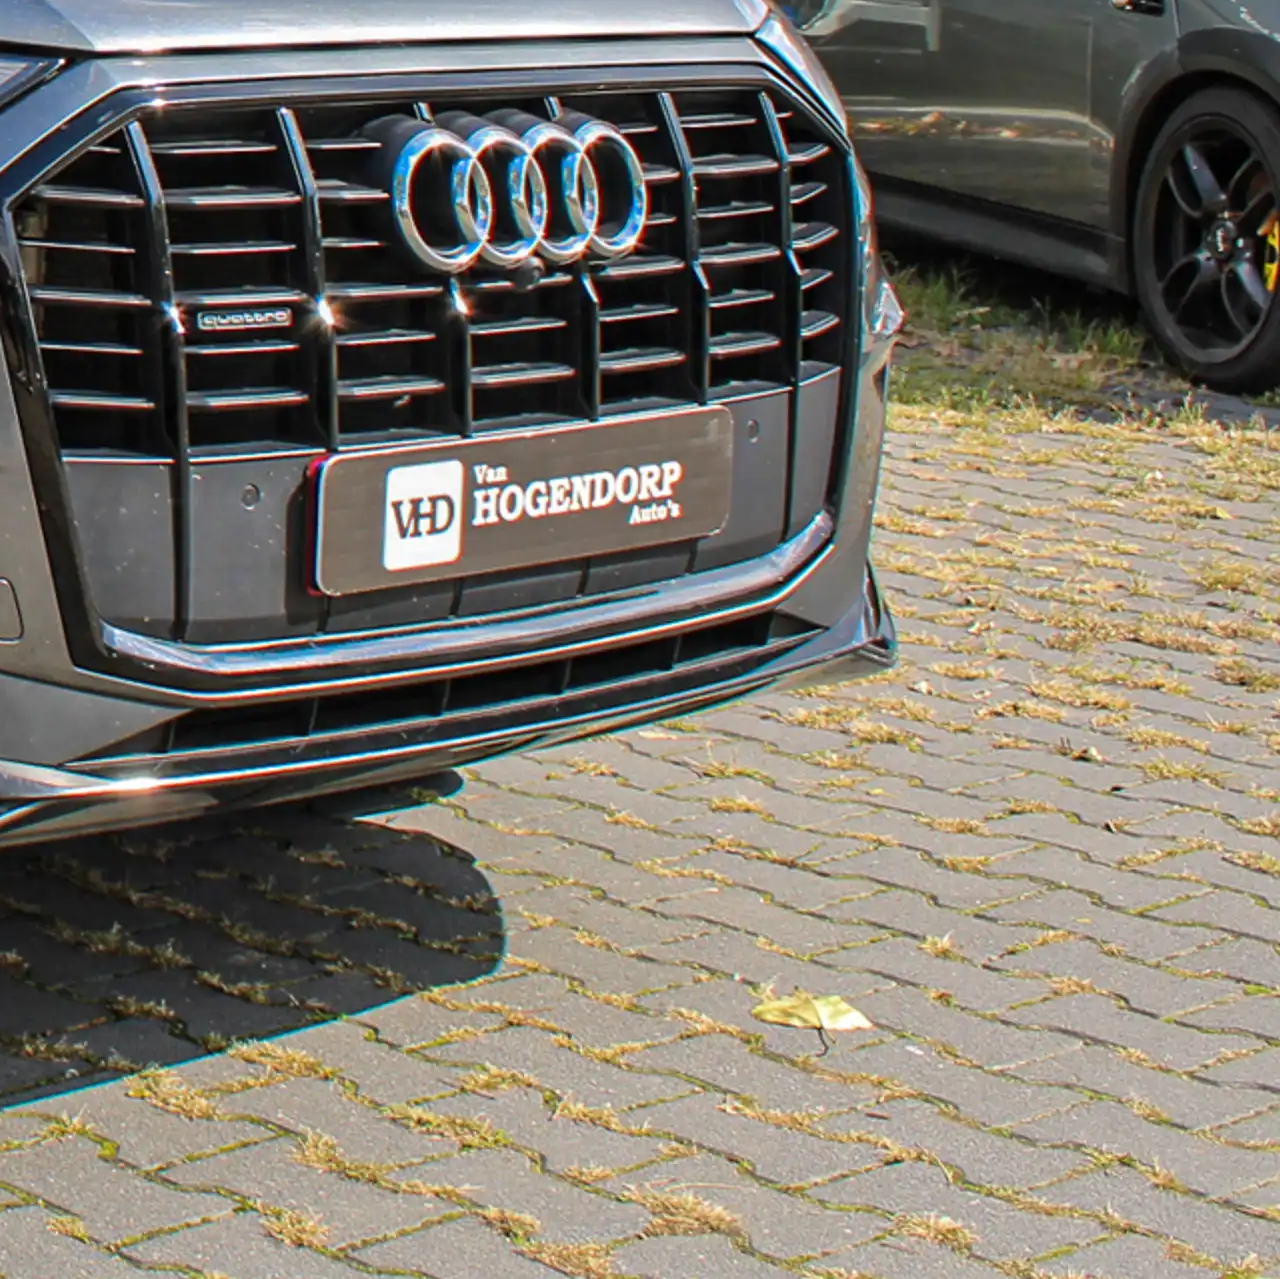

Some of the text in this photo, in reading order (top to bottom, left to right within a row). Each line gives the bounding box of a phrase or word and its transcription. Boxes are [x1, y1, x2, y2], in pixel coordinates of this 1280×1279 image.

[203, 310, 288, 328] quattro
[473, 464, 508, 484] Van
[472, 461, 684, 526] HOGENDORP
[391, 494, 454, 539] VHD
[629, 499, 682, 525] Auto's
